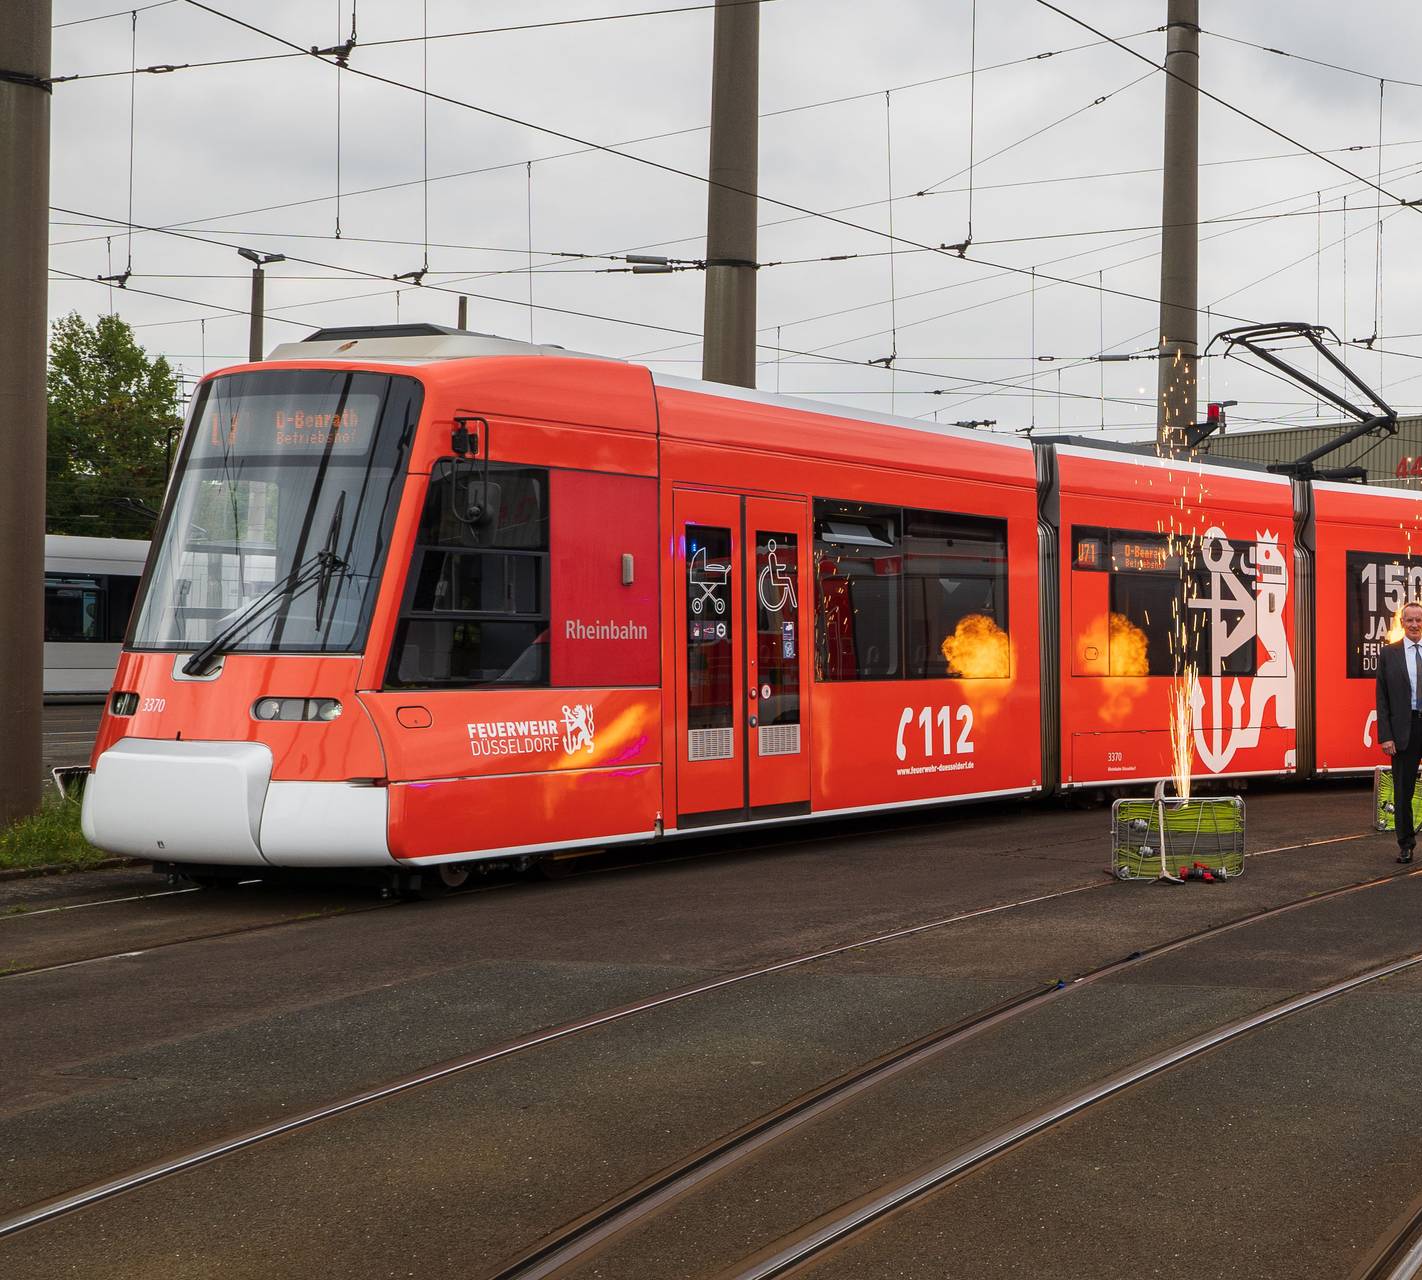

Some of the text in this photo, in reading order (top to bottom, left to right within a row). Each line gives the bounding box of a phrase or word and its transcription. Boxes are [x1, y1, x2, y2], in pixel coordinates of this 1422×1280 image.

[1397, 457, 1422, 479] 44
[1078, 543, 1095, 563] U71
[565, 619, 648, 640] Rheinbahn
[142, 697, 166, 713] 3370
[467, 720, 558, 739] FEUERWEHR
[919, 704, 974, 756] 112
[470, 737, 560, 756] DÜSSELDORF
[1108, 752, 1122, 761] 3370
[896, 761, 975, 776] www.feuerwehr-duesseldorf.de
